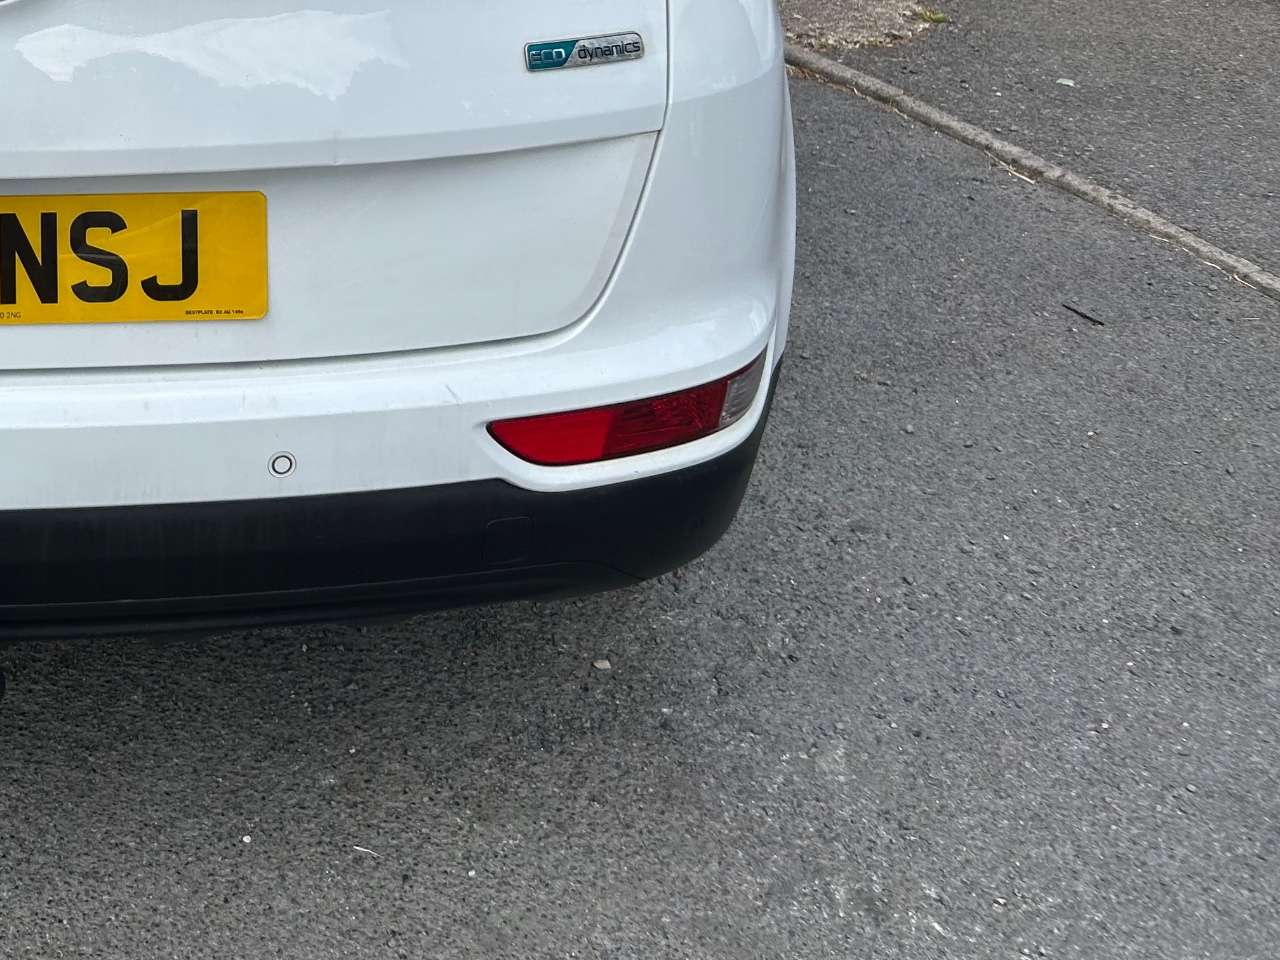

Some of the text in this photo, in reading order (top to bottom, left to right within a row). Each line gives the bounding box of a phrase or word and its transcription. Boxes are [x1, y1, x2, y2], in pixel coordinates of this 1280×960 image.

[577, 41, 641, 61] dynamics
[0, 209, 200, 307] NSJ
[6, 311, 22, 320] 2NG
